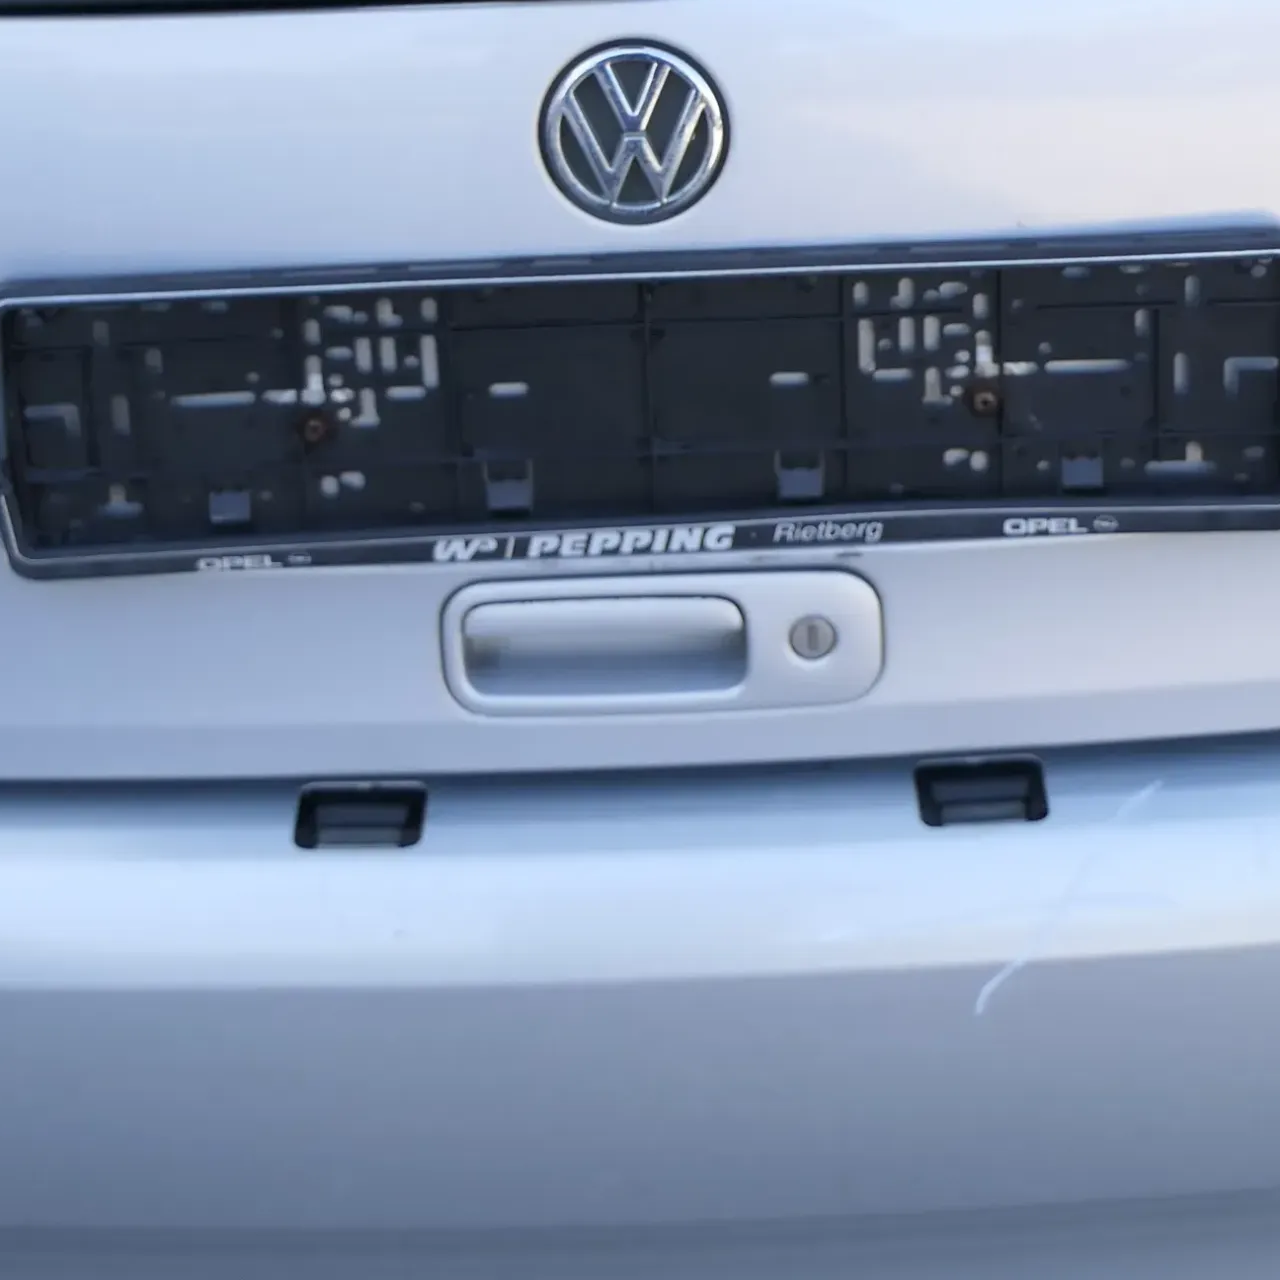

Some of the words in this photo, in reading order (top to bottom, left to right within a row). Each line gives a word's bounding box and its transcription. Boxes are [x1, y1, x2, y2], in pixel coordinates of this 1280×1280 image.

[1002, 516, 1089, 537] OPEL
[527, 523, 736, 559] PEPPING
[772, 519, 884, 544] Rietberg
[196, 554, 283, 572] OPEL
